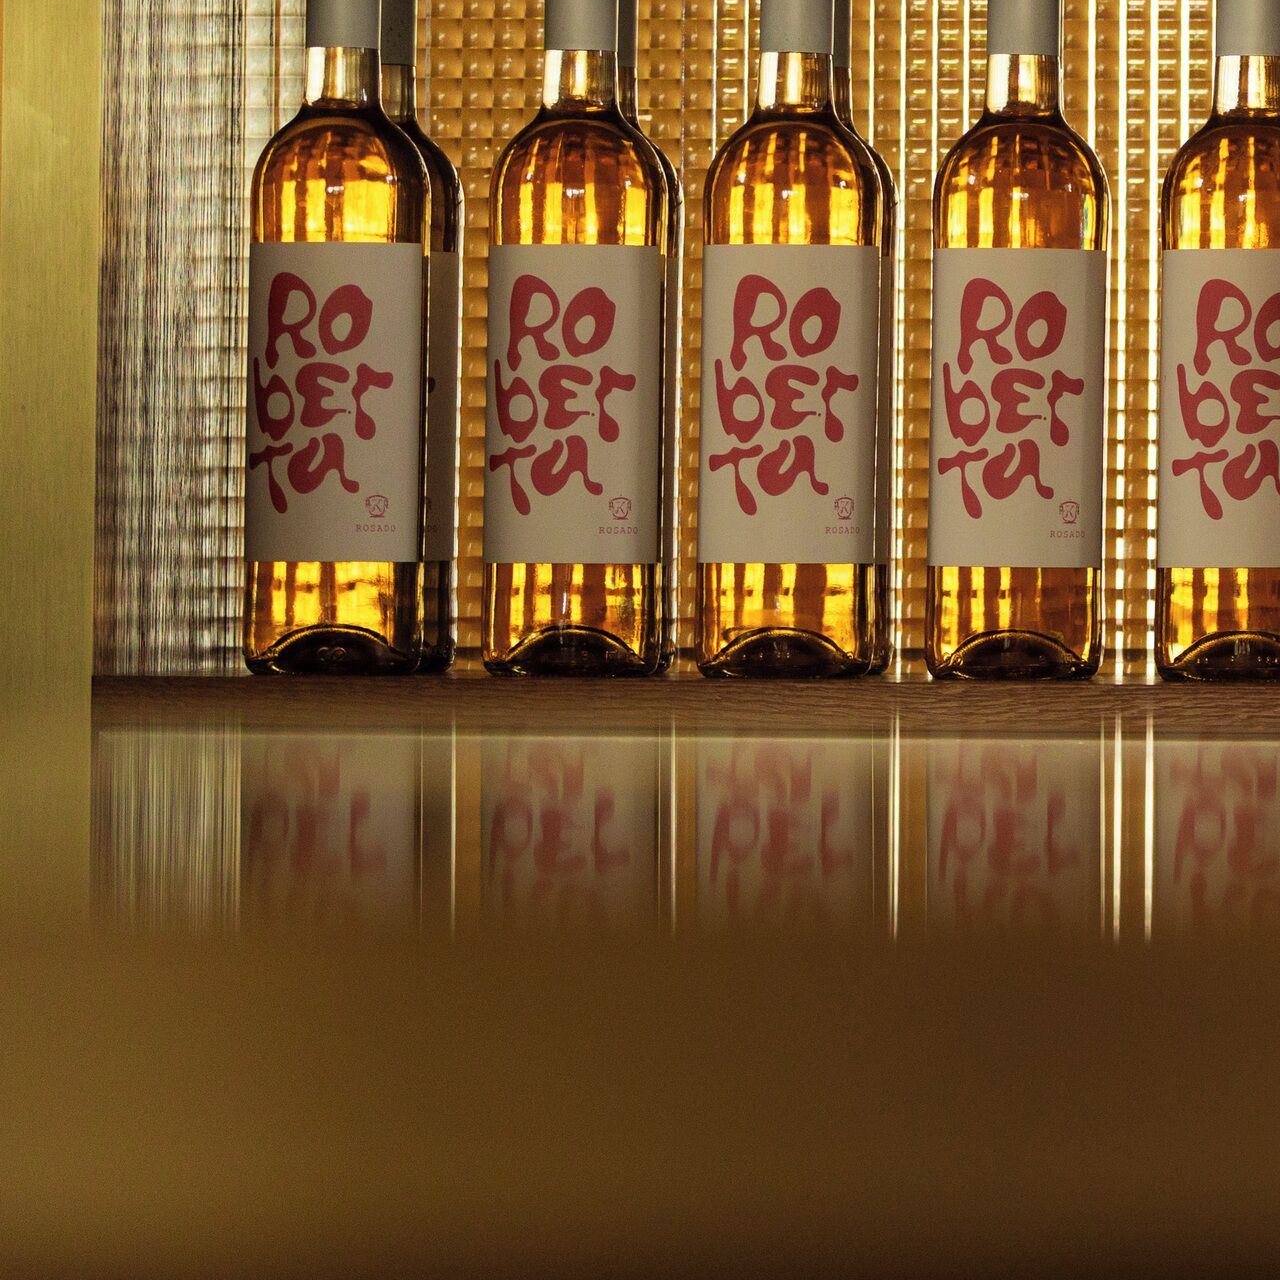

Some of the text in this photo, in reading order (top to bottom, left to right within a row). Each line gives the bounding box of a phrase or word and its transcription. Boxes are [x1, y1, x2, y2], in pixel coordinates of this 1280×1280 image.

[355, 523, 397, 534] ROSADO
[597, 526, 640, 536] ROSADO
[824, 526, 861, 536] ROSADO
[1049, 530, 1086, 539] ROSADO
